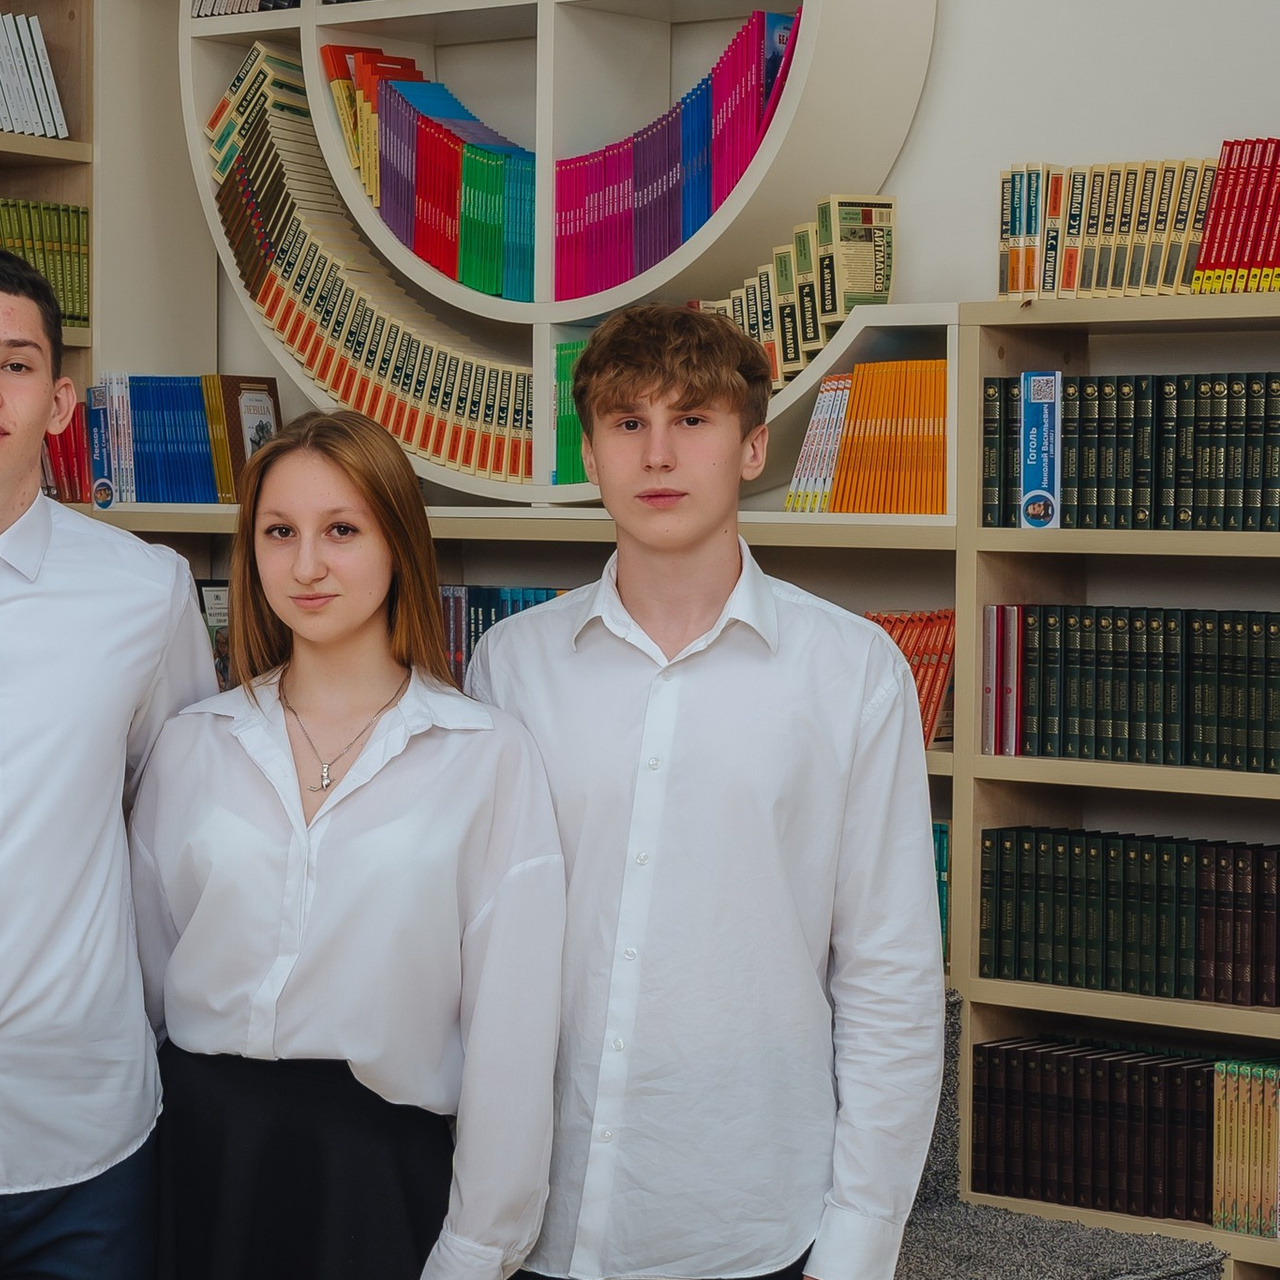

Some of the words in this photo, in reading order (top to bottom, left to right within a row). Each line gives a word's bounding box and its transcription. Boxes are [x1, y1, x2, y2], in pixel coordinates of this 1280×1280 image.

[240, 50, 258, 80] ПУШКИН
[1071, 175, 1083, 213] ПУШКИН
[1090, 176, 1102, 219] ШАЛАМОВ
[1106, 175, 1119, 217] ШАЛАМОВ
[1123, 174, 1136, 217] ШАЛАМОВ
[286, 220, 299, 250] ПУШКИН
[289, 232, 307, 264] ПУШКИН
[302, 245, 319, 277] ПУШКИН
[310, 257, 326, 289] ПУШКИН
[1044, 250, 1056, 290] ПУШКИН
[337, 289, 354, 322] ПУШКИН
[761, 274, 772, 311] ПУШКИН
[384, 326, 399, 359] ПУШКИН
[489, 371, 498, 405] ПУШКИН
[244, 405, 271, 415] ЛЕВША
[1027, 427, 1037, 465] Гоголь
